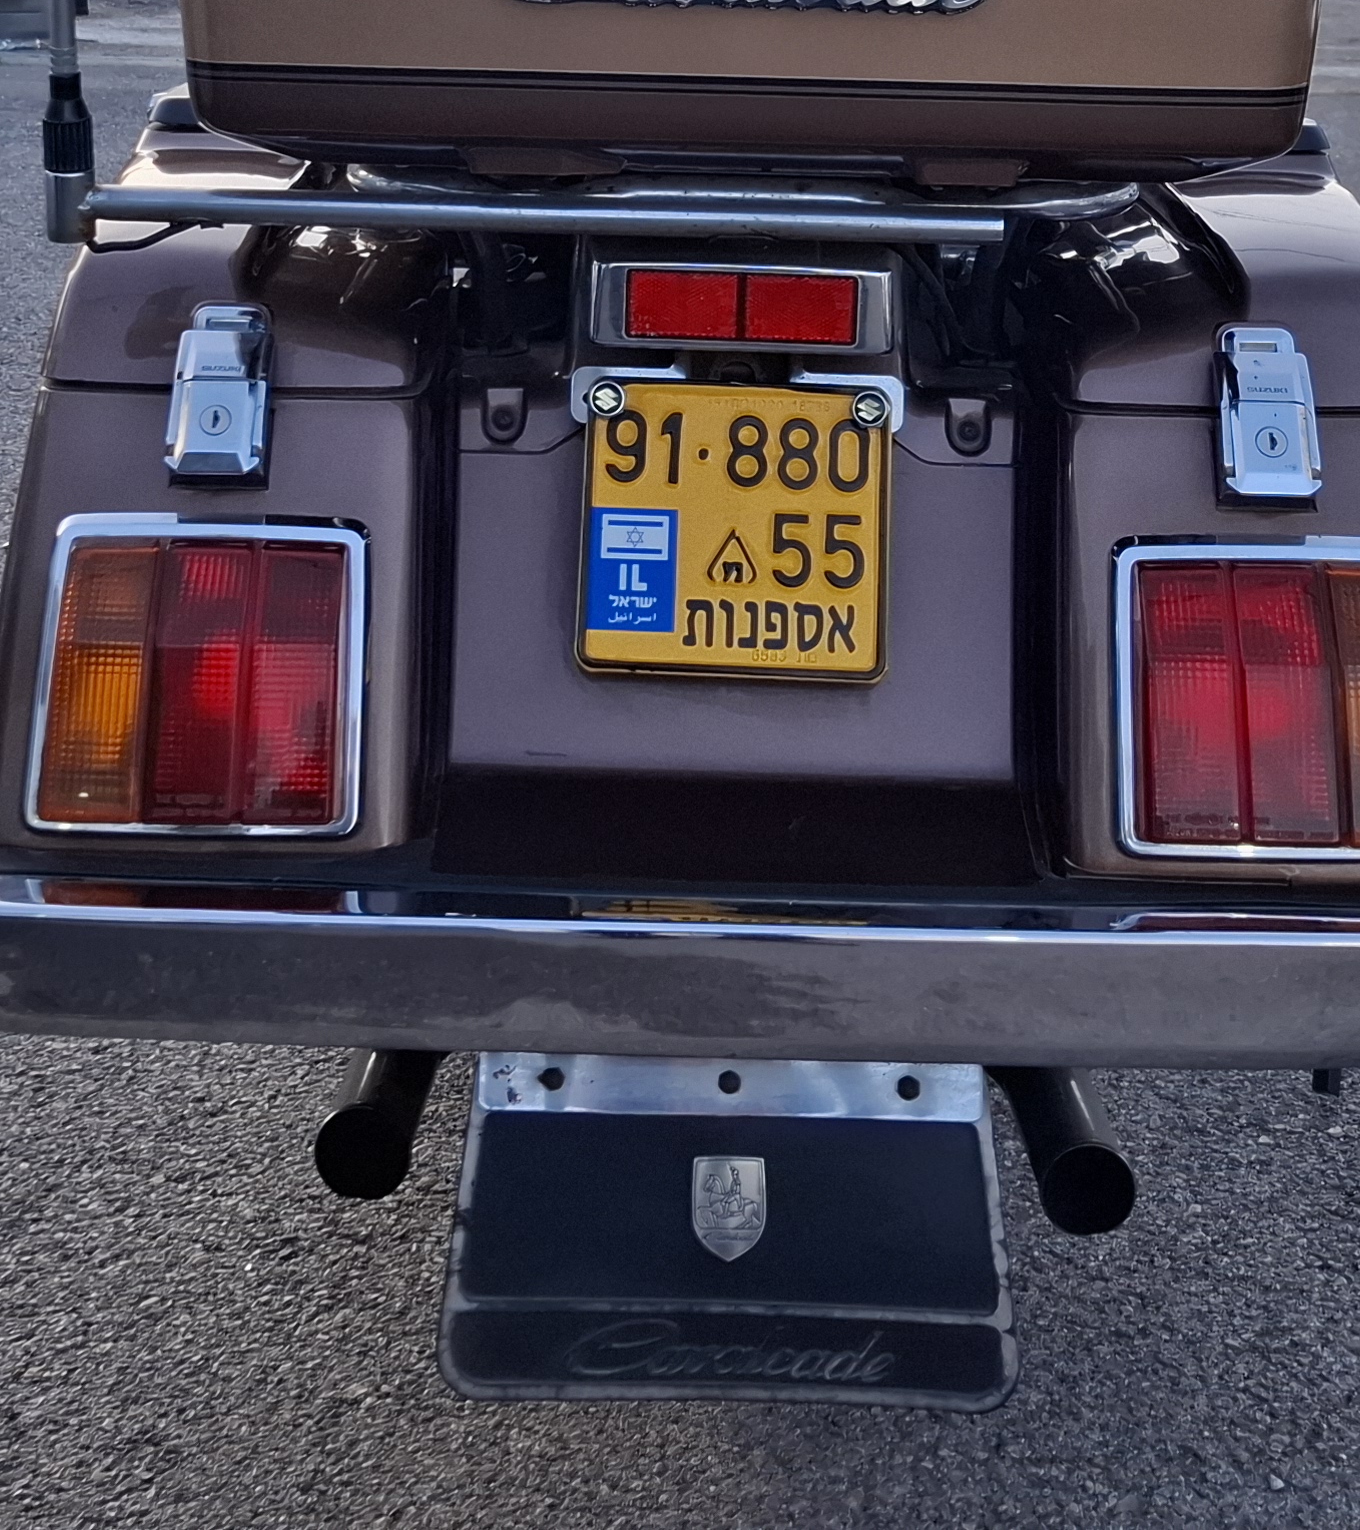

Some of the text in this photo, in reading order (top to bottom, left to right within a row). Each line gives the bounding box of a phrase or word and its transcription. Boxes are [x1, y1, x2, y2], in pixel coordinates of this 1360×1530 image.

[772, 513, 865, 589] 55
[618, 563, 648, 591] IL
[608, 594, 658, 608] ישראל
[682, 598, 856, 654] אספנות
